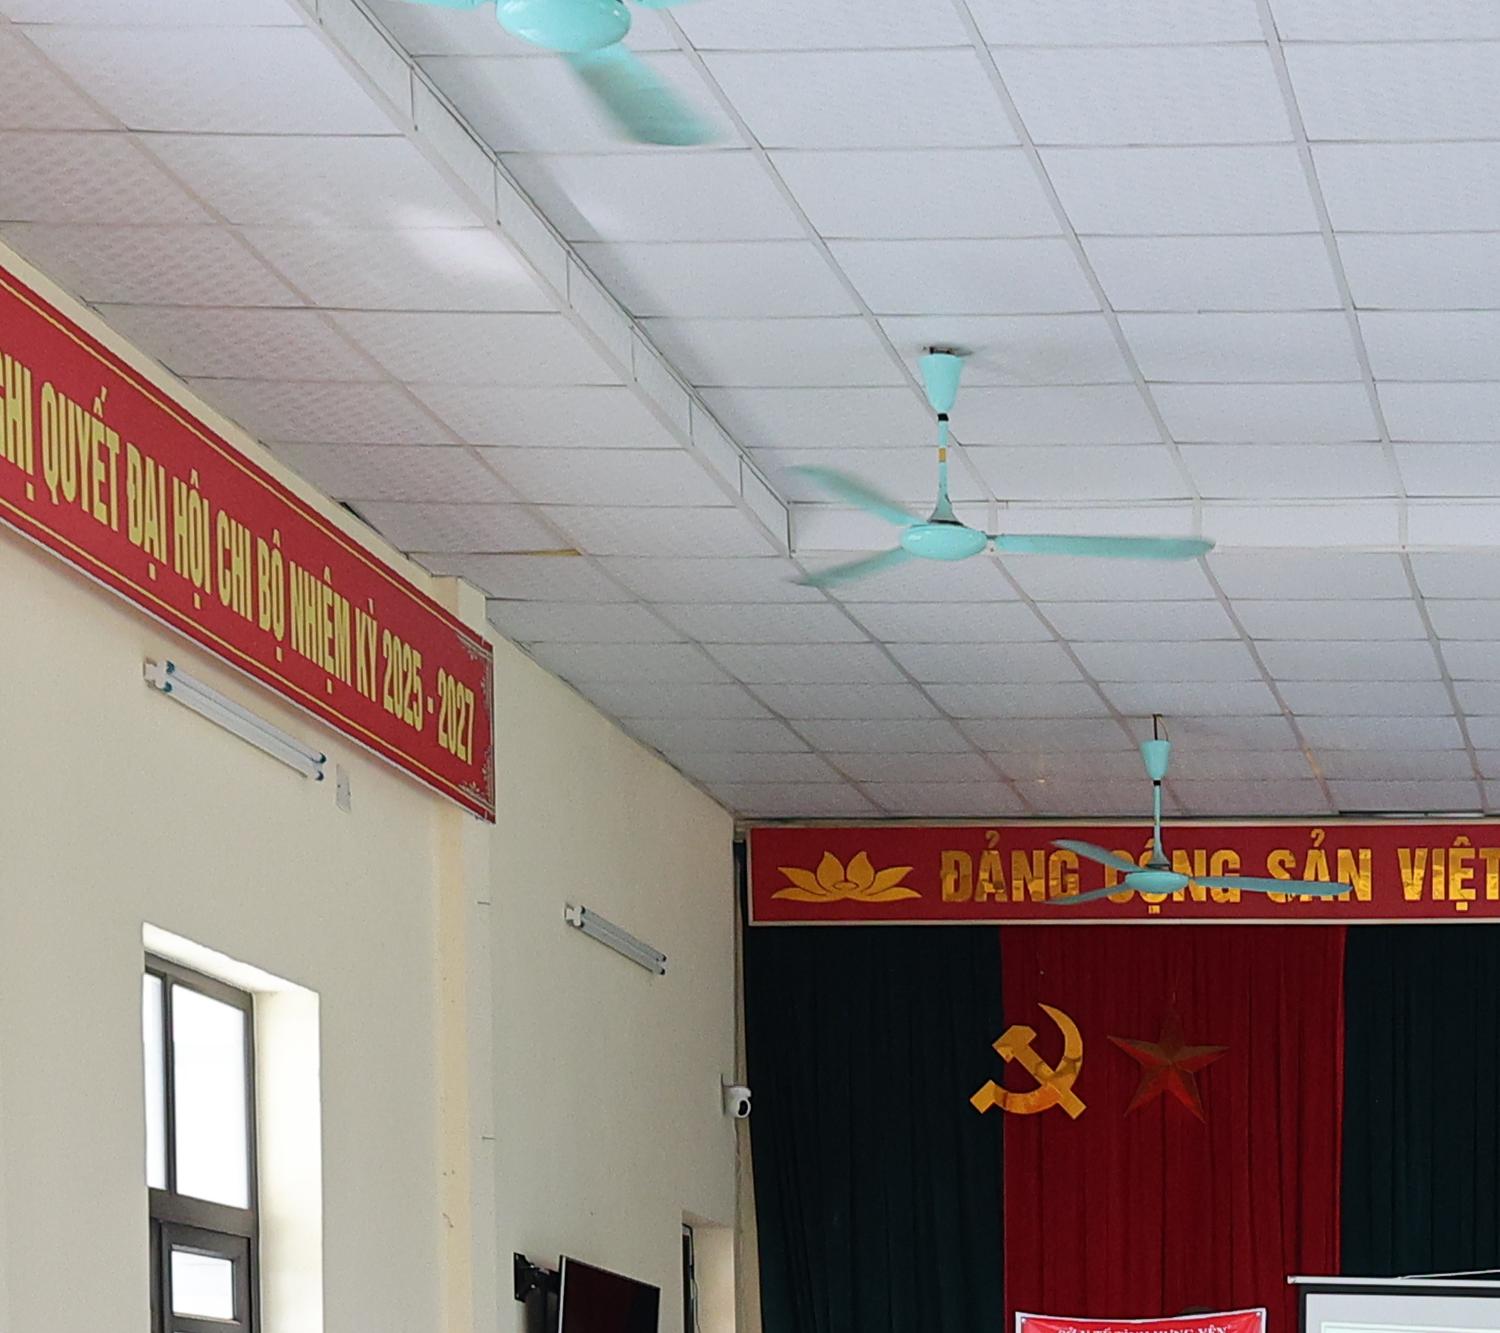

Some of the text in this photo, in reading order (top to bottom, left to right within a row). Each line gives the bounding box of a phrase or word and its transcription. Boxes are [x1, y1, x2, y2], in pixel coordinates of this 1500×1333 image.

[41, 381, 120, 533] QUYẾT
[126, 440, 167, 580] ĐẠI
[172, 468, 212, 608] HỘI
[216, 509, 253, 622] CHI
[257, 528, 285, 661] BỘ
[289, 559, 352, 693] NHIỆM
[355, 597, 380, 702] KỲ
[382, 628, 423, 732] 2025
[437, 667, 474, 765] 2027
[939, 830, 1079, 903] ĐẢNG
[1266, 829, 1372, 903] SẢN
